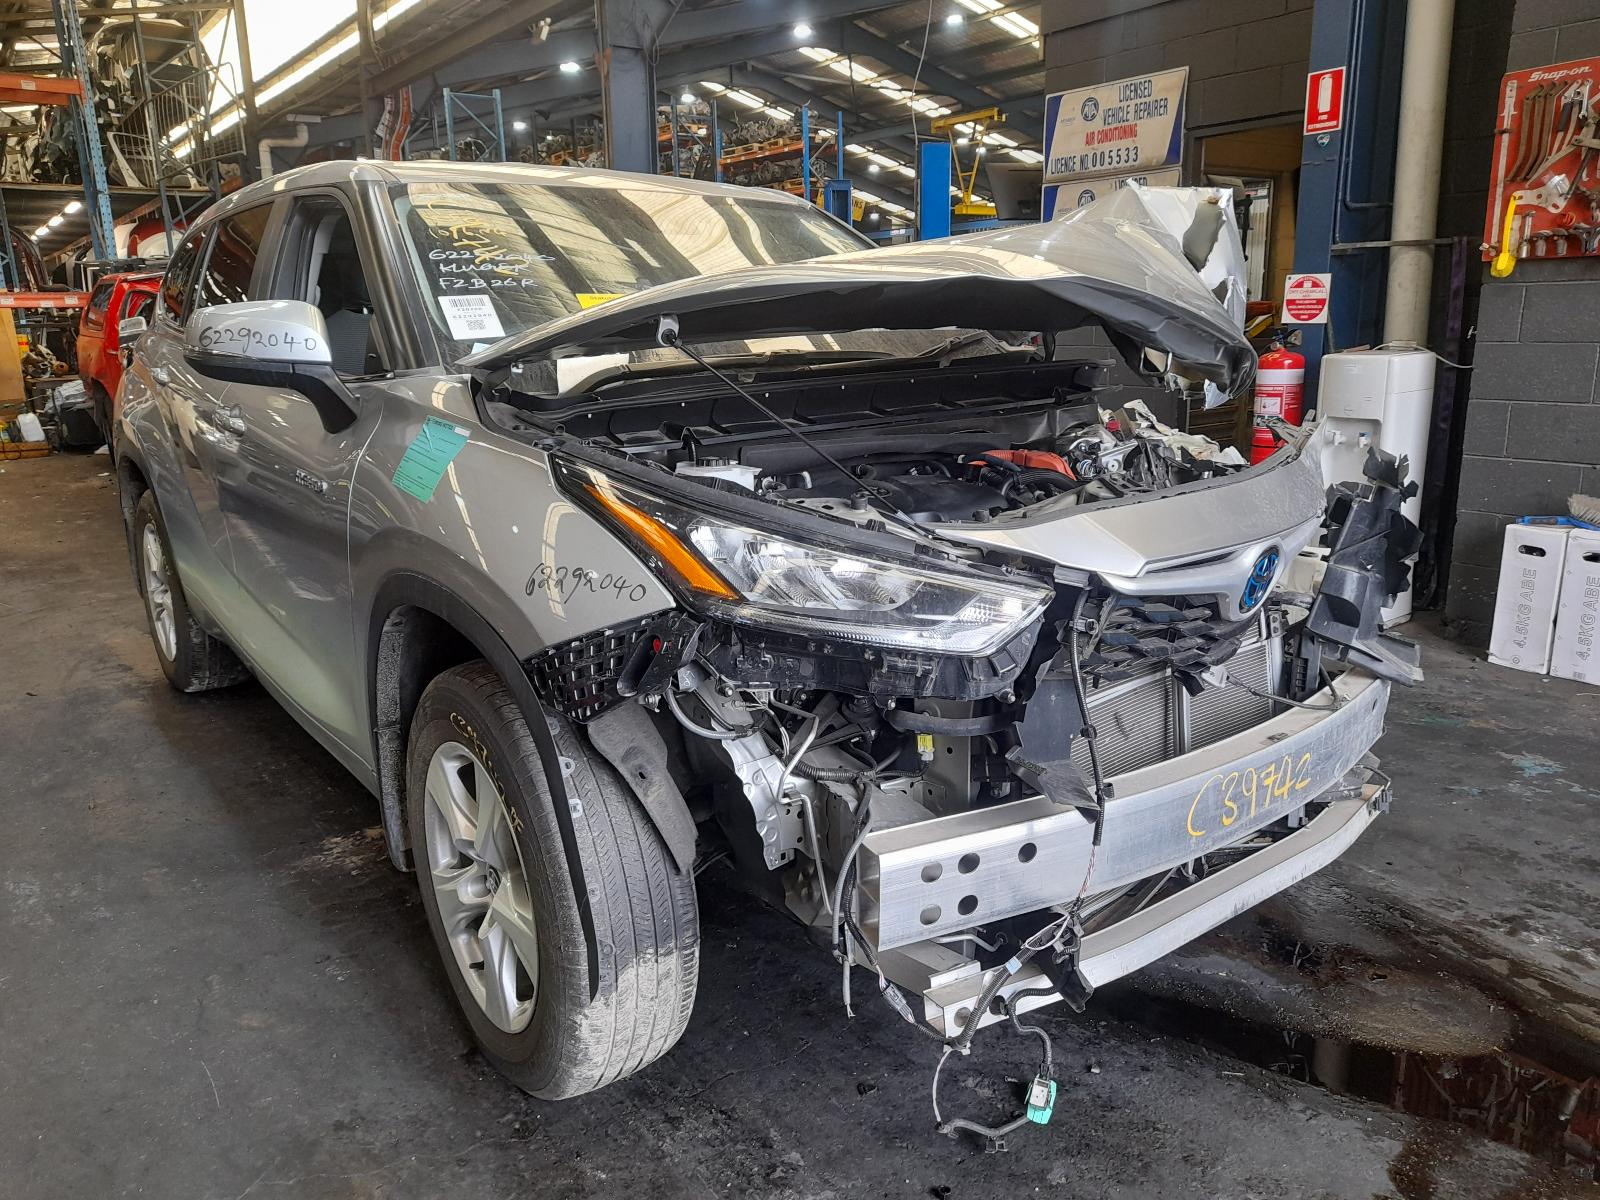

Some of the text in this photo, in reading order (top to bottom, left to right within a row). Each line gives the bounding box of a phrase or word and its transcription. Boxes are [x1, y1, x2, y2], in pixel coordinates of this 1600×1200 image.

[1528, 66, 1592, 82] Snap-on
[1119, 80, 1152, 102] LICENSED
[1103, 98, 1168, 126] VEHICLE REPAIRER
[1085, 123, 1138, 146] AIR CONDITIONING
[1051, 155, 1076, 175] LICENCE
[1092, 146, 1138, 168] 005533
[198, 326, 317, 354] 62292040
[525, 562, 647, 604] 62292040
[1512, 568, 1537, 649] 4.5KG ABE
[1575, 613, 1596, 661] 4.5KG
[1187, 752, 1312, 837] C39742
